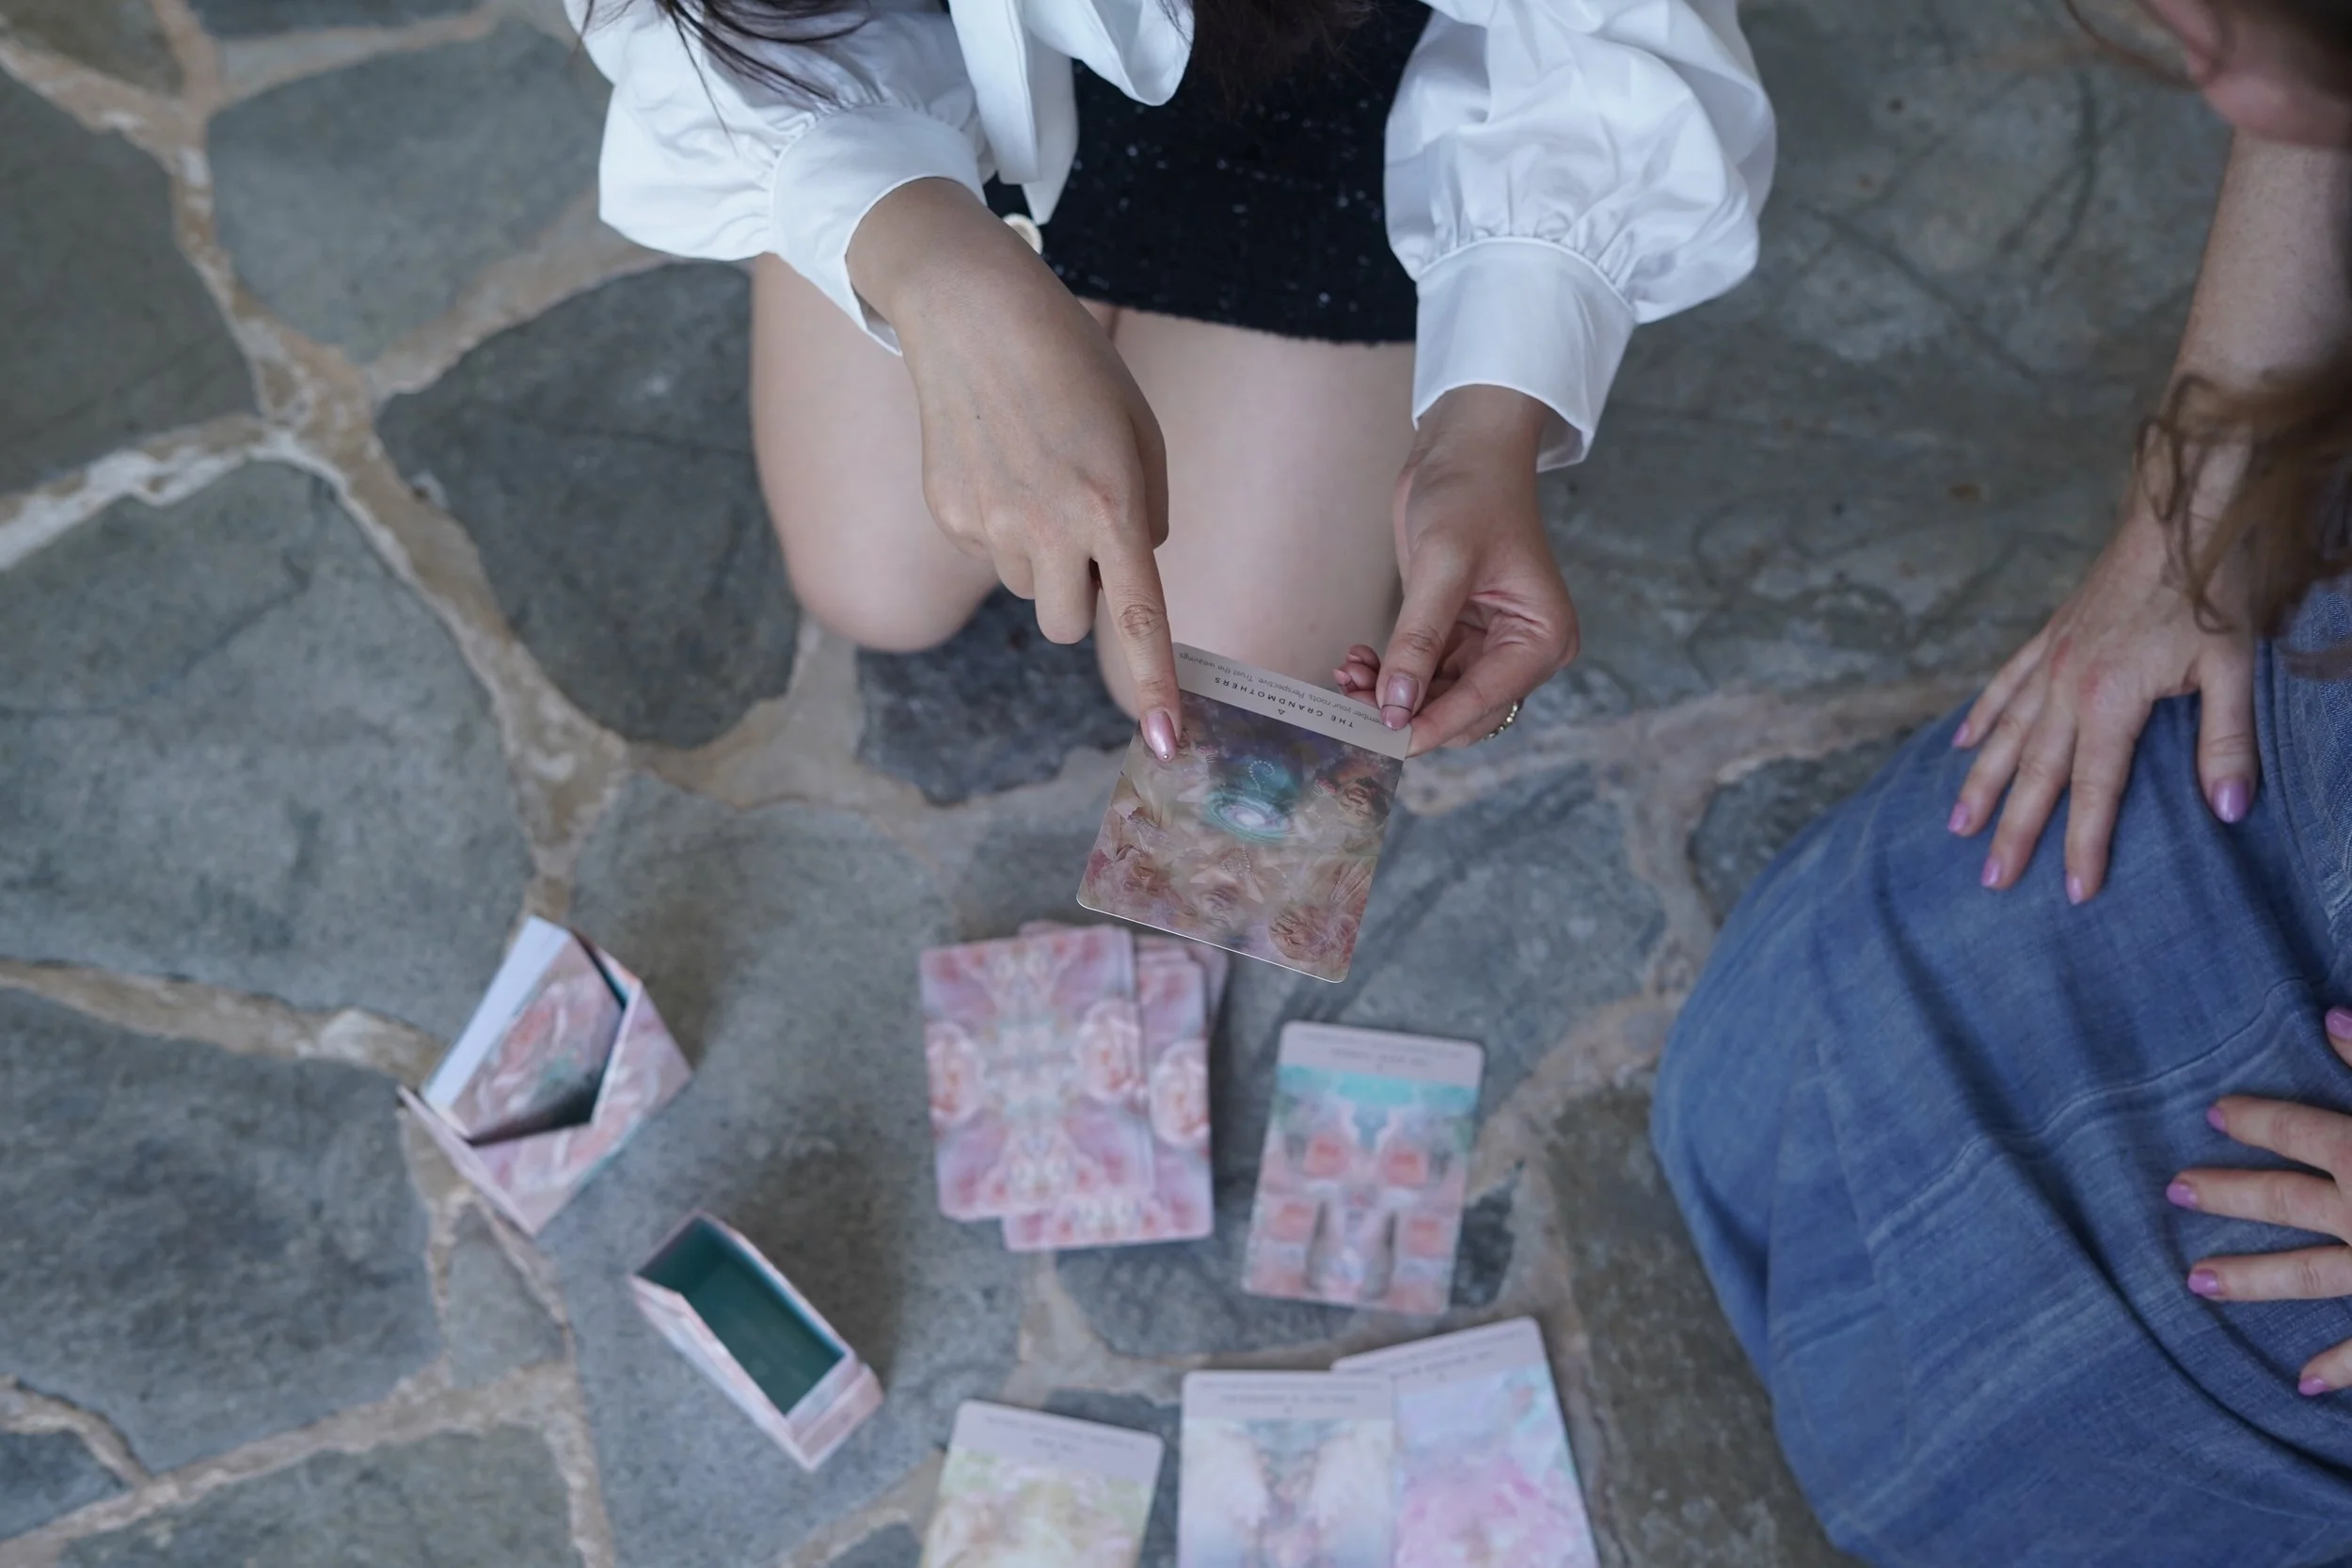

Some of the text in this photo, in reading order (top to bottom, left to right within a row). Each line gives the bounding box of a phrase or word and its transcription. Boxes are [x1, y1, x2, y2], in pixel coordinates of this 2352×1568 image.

[1217, 664, 1232, 674] the
[1232, 670, 1253, 683] Trust
[1214, 676, 1354, 728] THE GRANDMOTHERS
[1332, 703, 1352, 715] your
